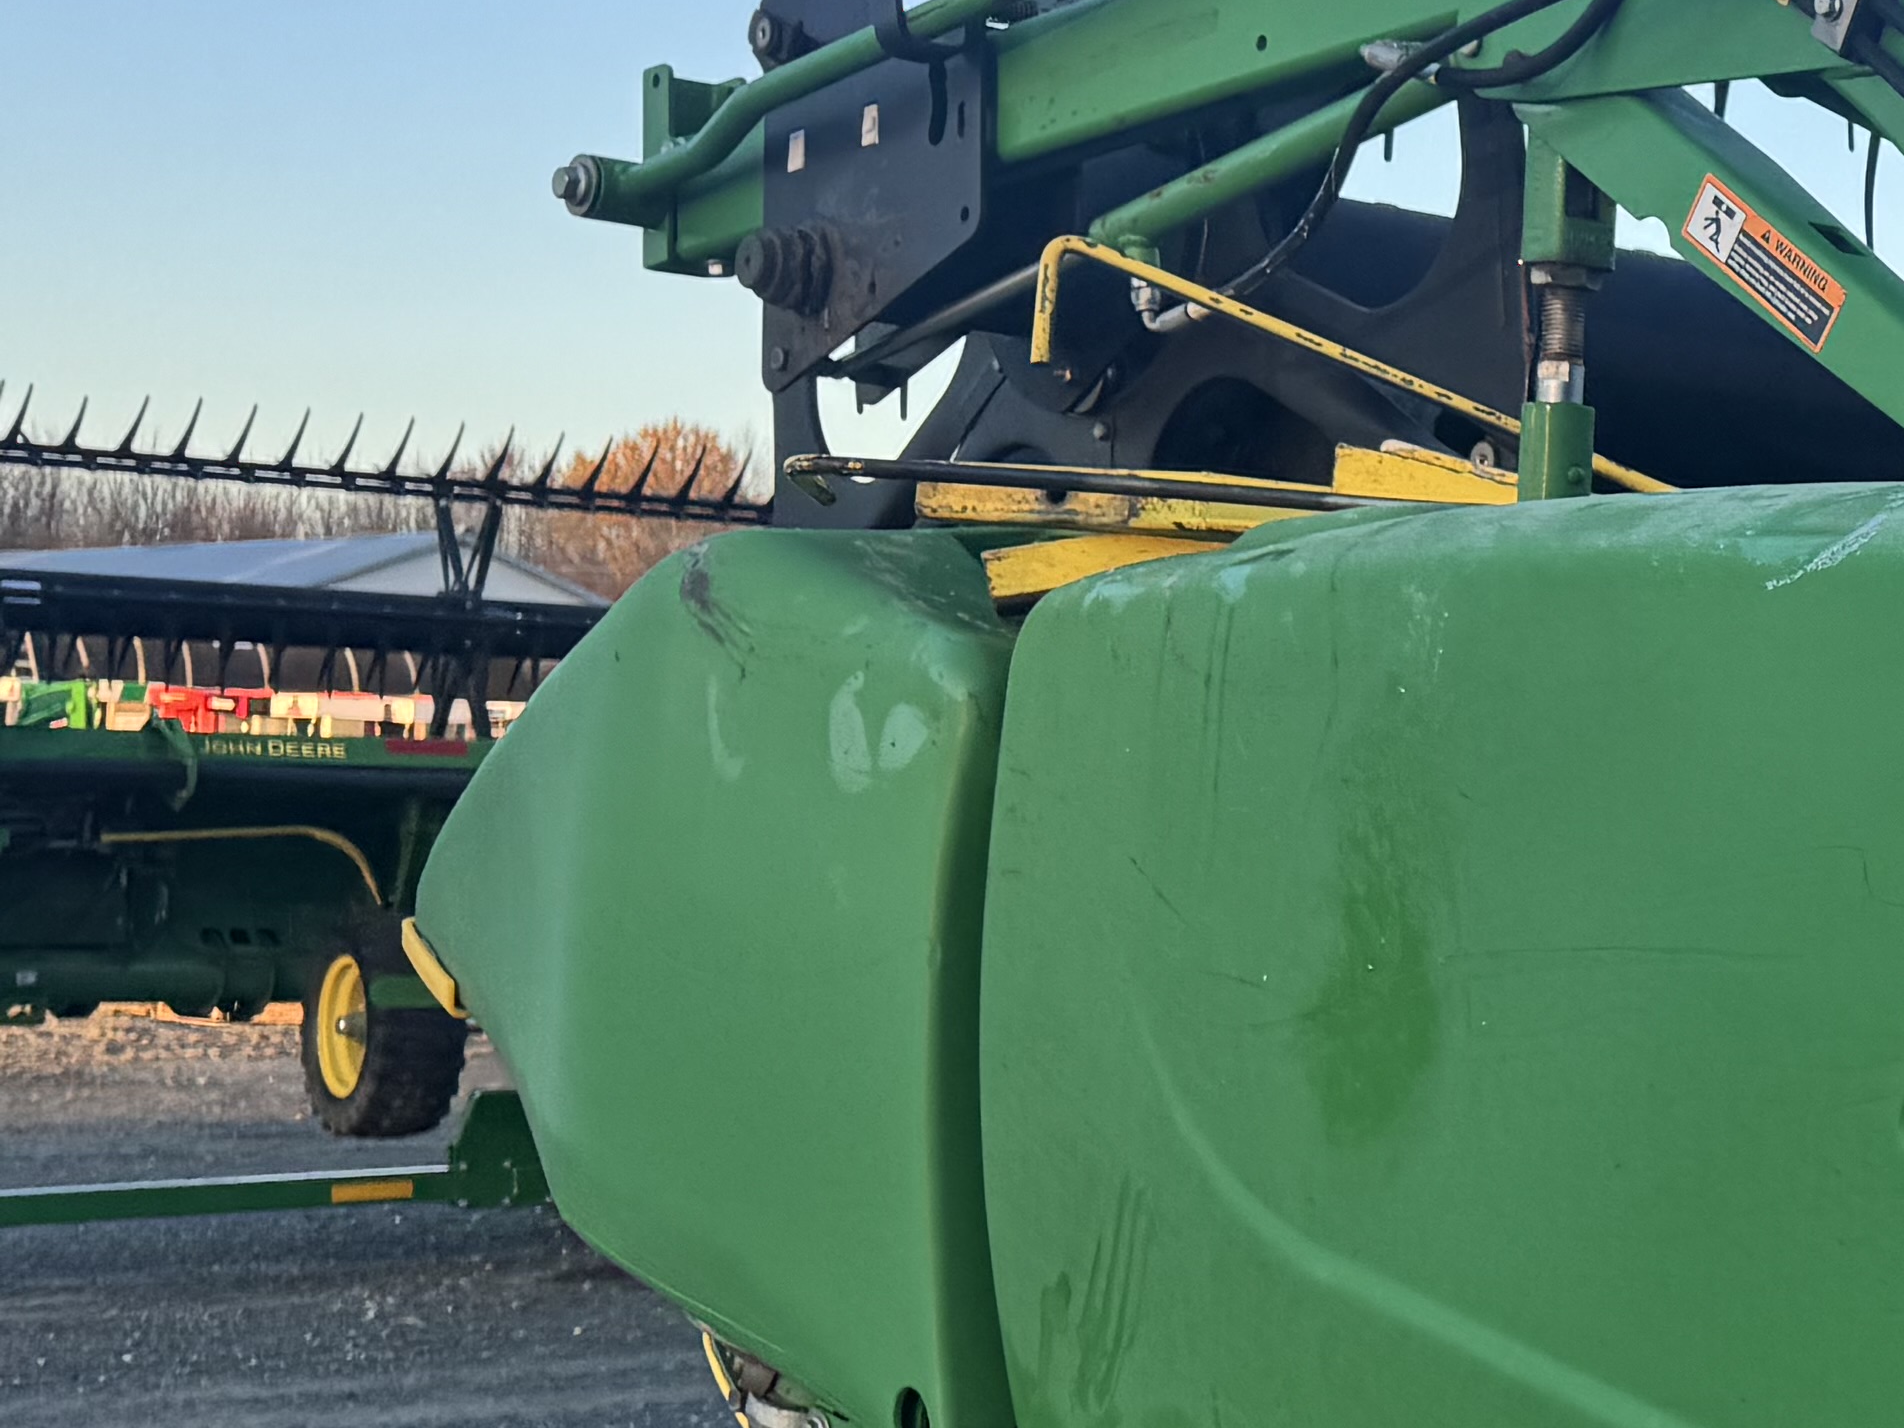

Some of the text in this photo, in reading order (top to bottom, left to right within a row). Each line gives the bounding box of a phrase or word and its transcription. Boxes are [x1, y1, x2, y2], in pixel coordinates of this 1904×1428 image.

[1774, 239, 1829, 294] WARNING
[203, 736, 346, 759] JOHN DEERE
